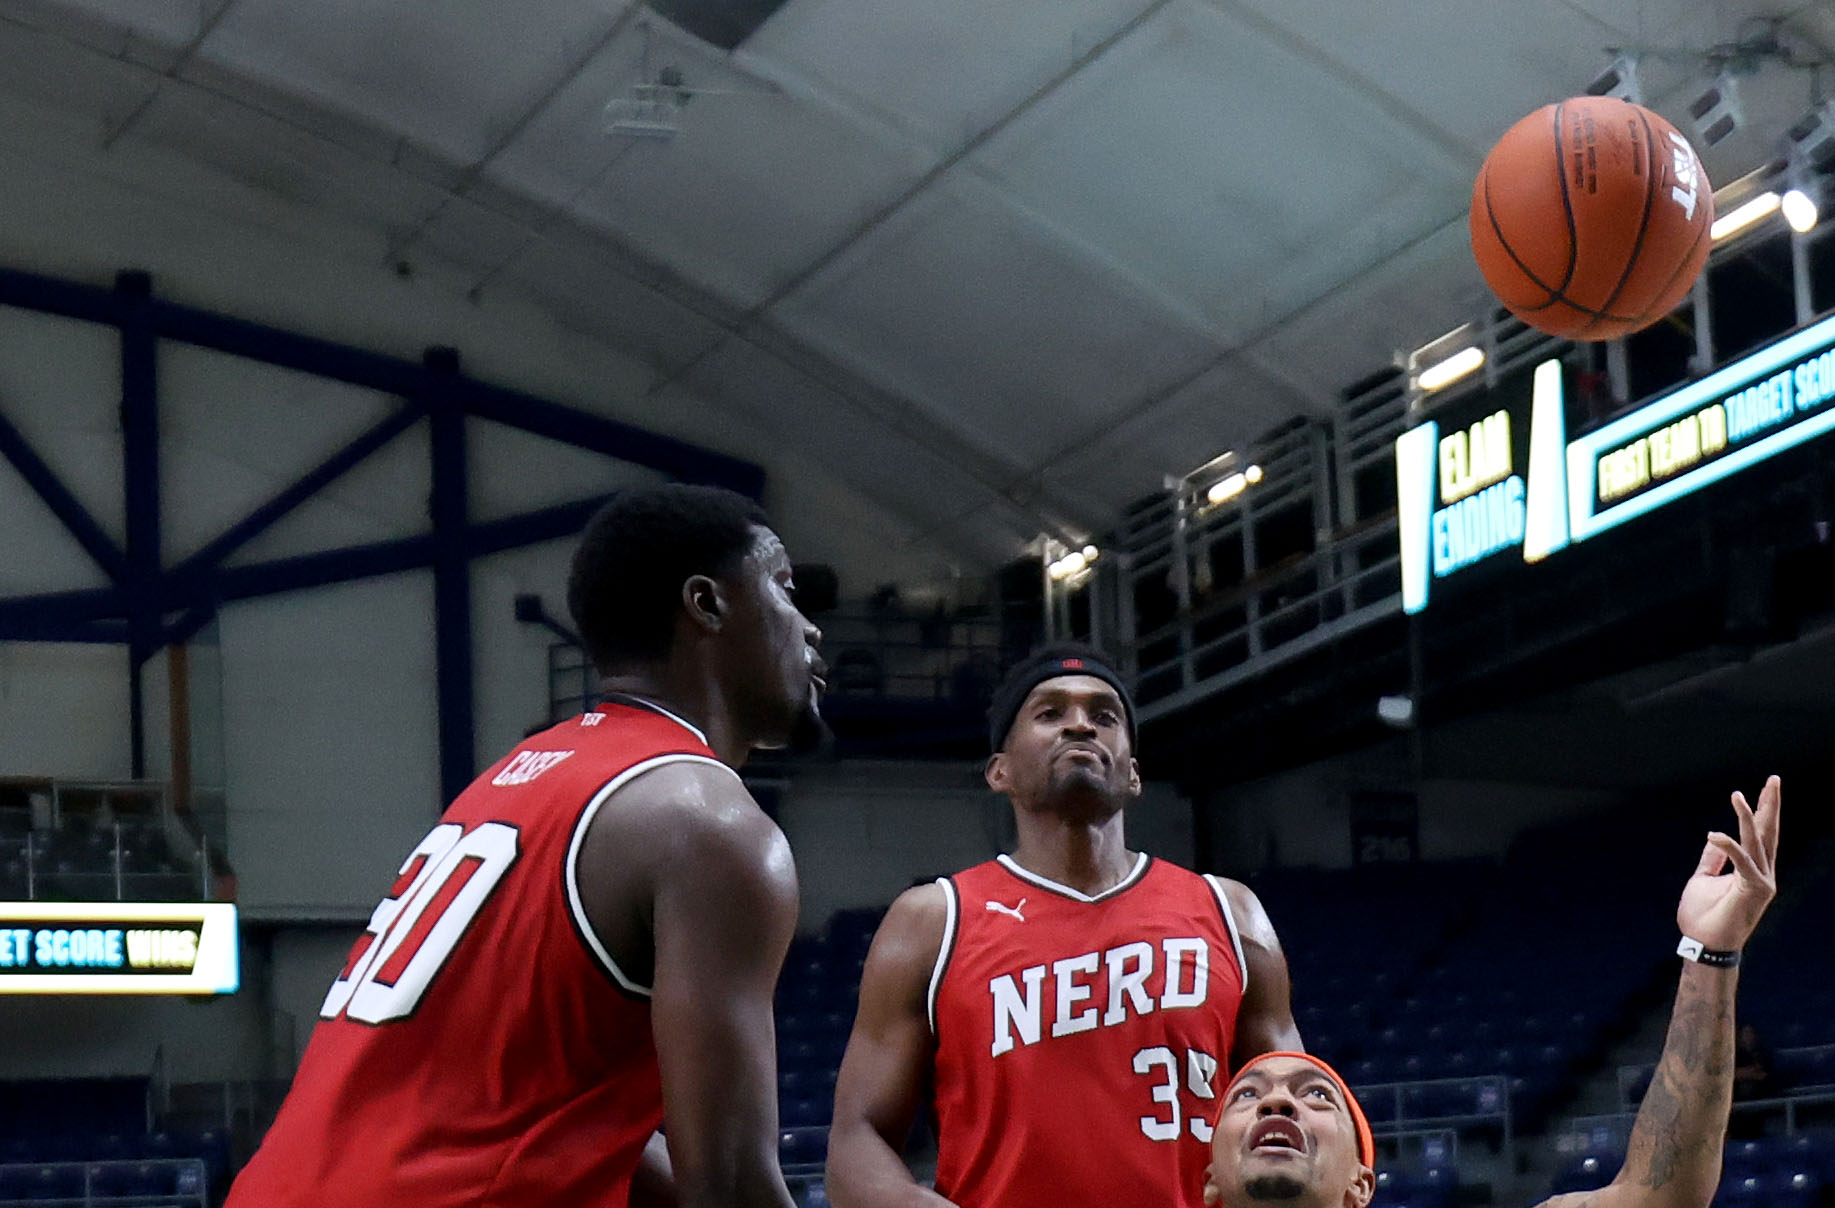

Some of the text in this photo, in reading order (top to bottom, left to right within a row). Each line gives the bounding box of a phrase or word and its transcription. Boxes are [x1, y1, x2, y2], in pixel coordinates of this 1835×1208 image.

[1439, 409, 1513, 505] ELAM
[1599, 438, 1650, 502] FIRST
[1649, 414, 1701, 480] TEAM
[1699, 403, 1728, 458] TO
[1724, 369, 1794, 443] TARGET
[1431, 474, 1526, 579] ENDING
[35, 928, 125, 968] SCORE
[126, 928, 199, 968] WINS
[319, 820, 523, 1029] 30
[989, 936, 1211, 1059] NERD
